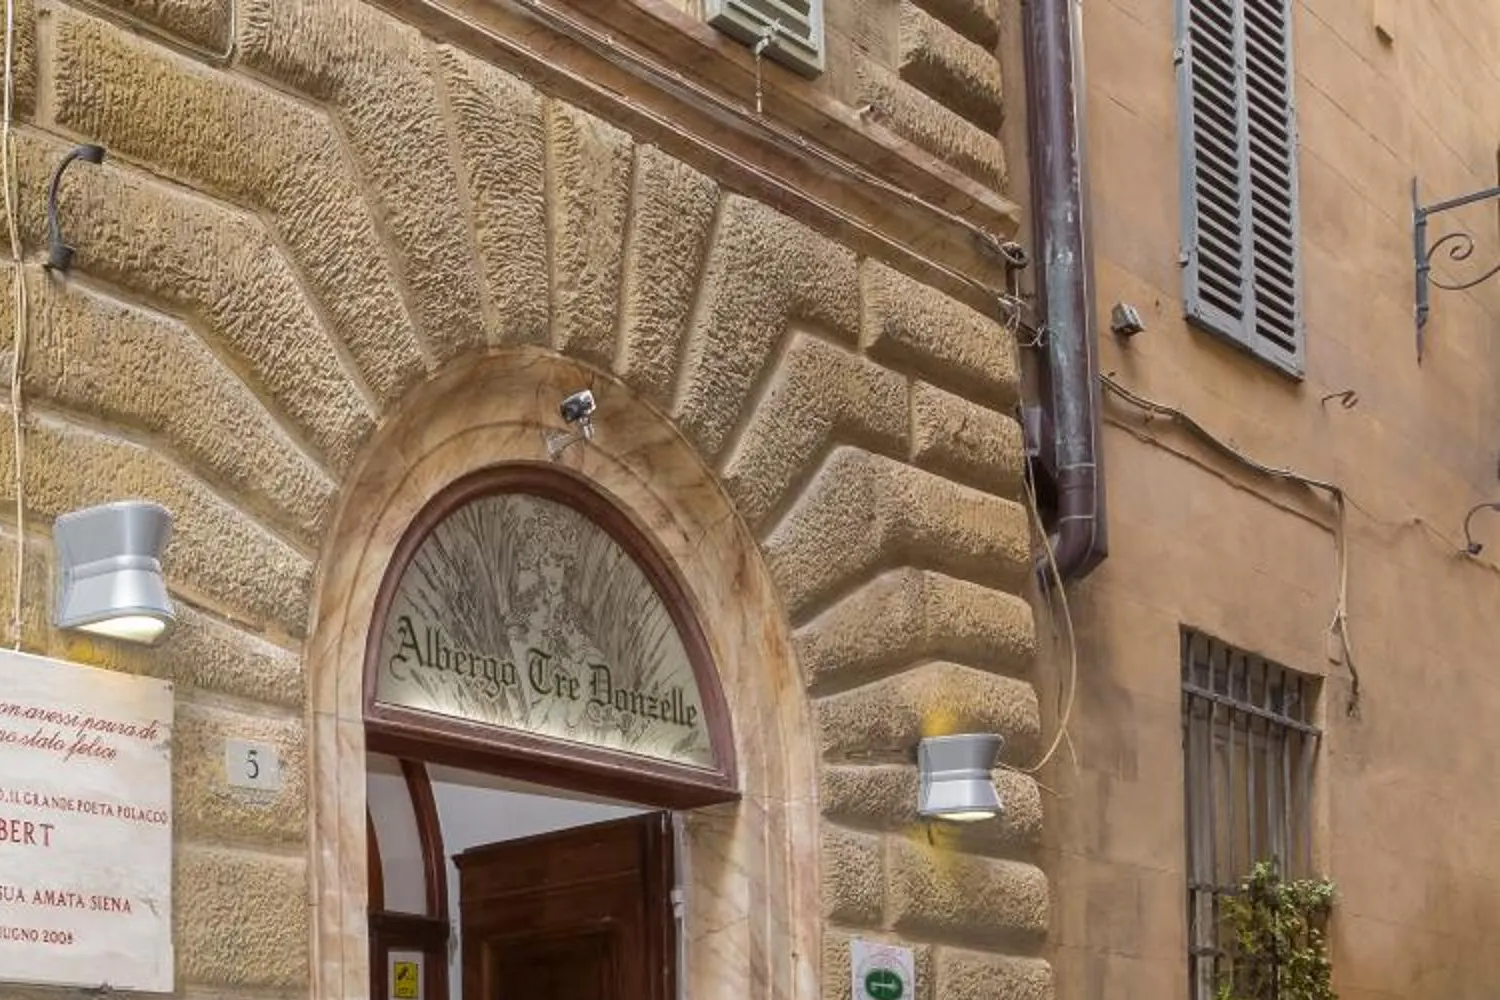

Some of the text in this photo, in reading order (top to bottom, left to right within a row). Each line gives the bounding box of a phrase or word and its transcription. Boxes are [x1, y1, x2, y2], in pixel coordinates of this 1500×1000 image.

[389, 615, 698, 729] Albergo Tre Donzelle
[21, 728, 65, 751] stato
[22, 706, 79, 727] avessi
[76, 717, 135, 737] paura
[137, 719, 159, 741] di
[246, 749, 259, 779] 5
[9, 790, 23, 803] IL
[23, 792, 77, 811] GRANDE
[78, 800, 114, 817] POETA
[117, 803, 169, 825] POLACCO
[32, 889, 85, 909] AMATA
[91, 895, 132, 914] SIENA
